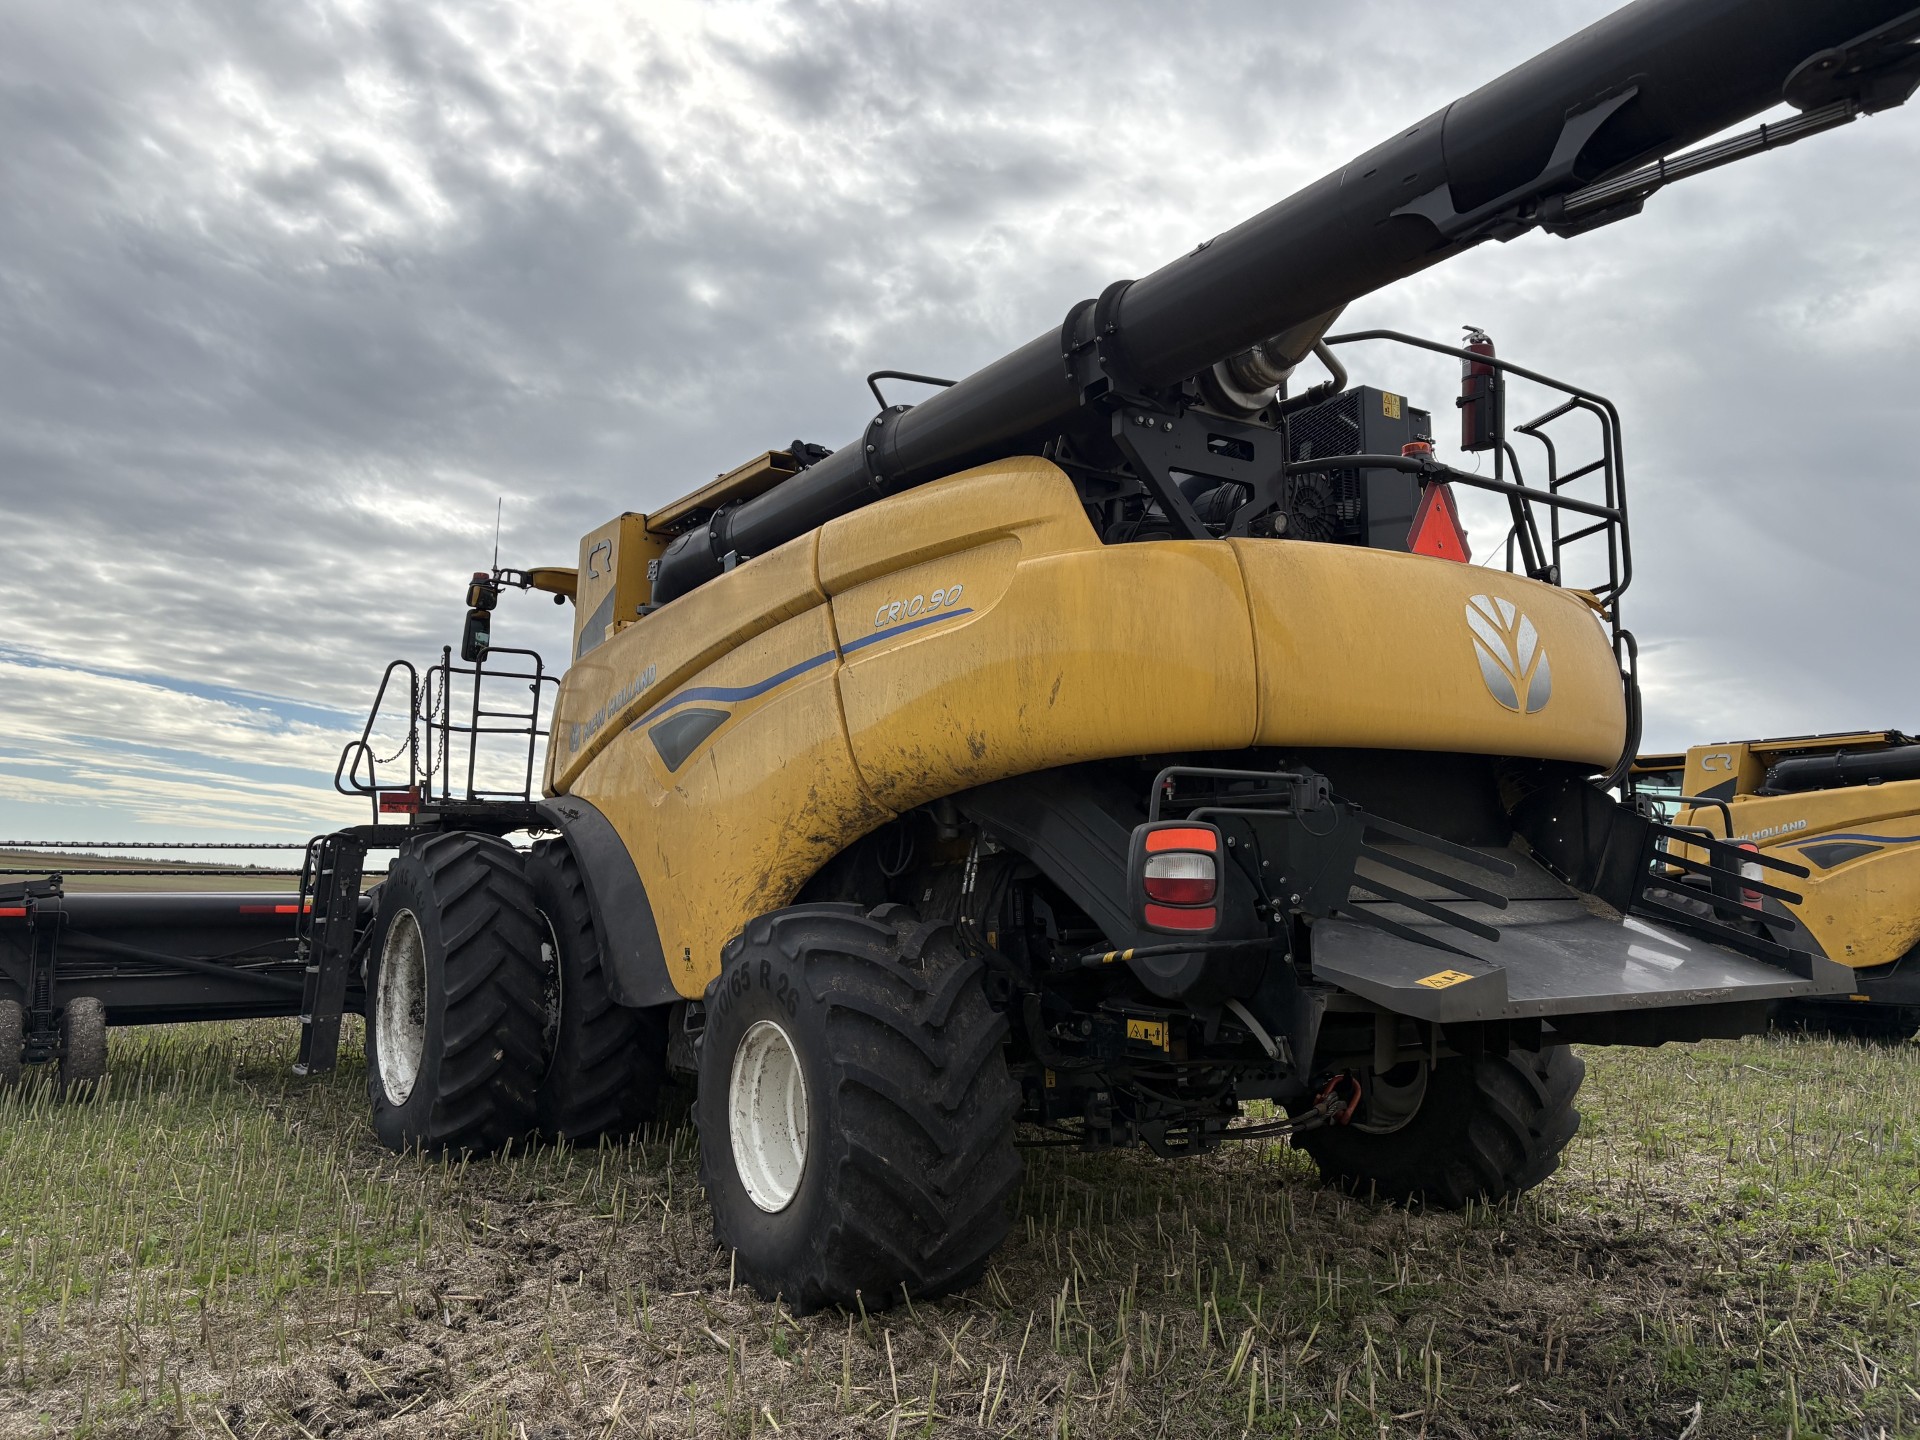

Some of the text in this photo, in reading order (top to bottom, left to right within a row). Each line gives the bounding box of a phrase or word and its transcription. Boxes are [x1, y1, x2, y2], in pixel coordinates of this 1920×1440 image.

[588, 539, 612, 579] CR
[874, 584, 964, 627] CR10.90
[583, 663, 656, 743] NEW HOLLAND
[1701, 754, 1732, 771] CR
[1752, 819, 1807, 841] HOLLAND
[760, 959, 772, 990] R
